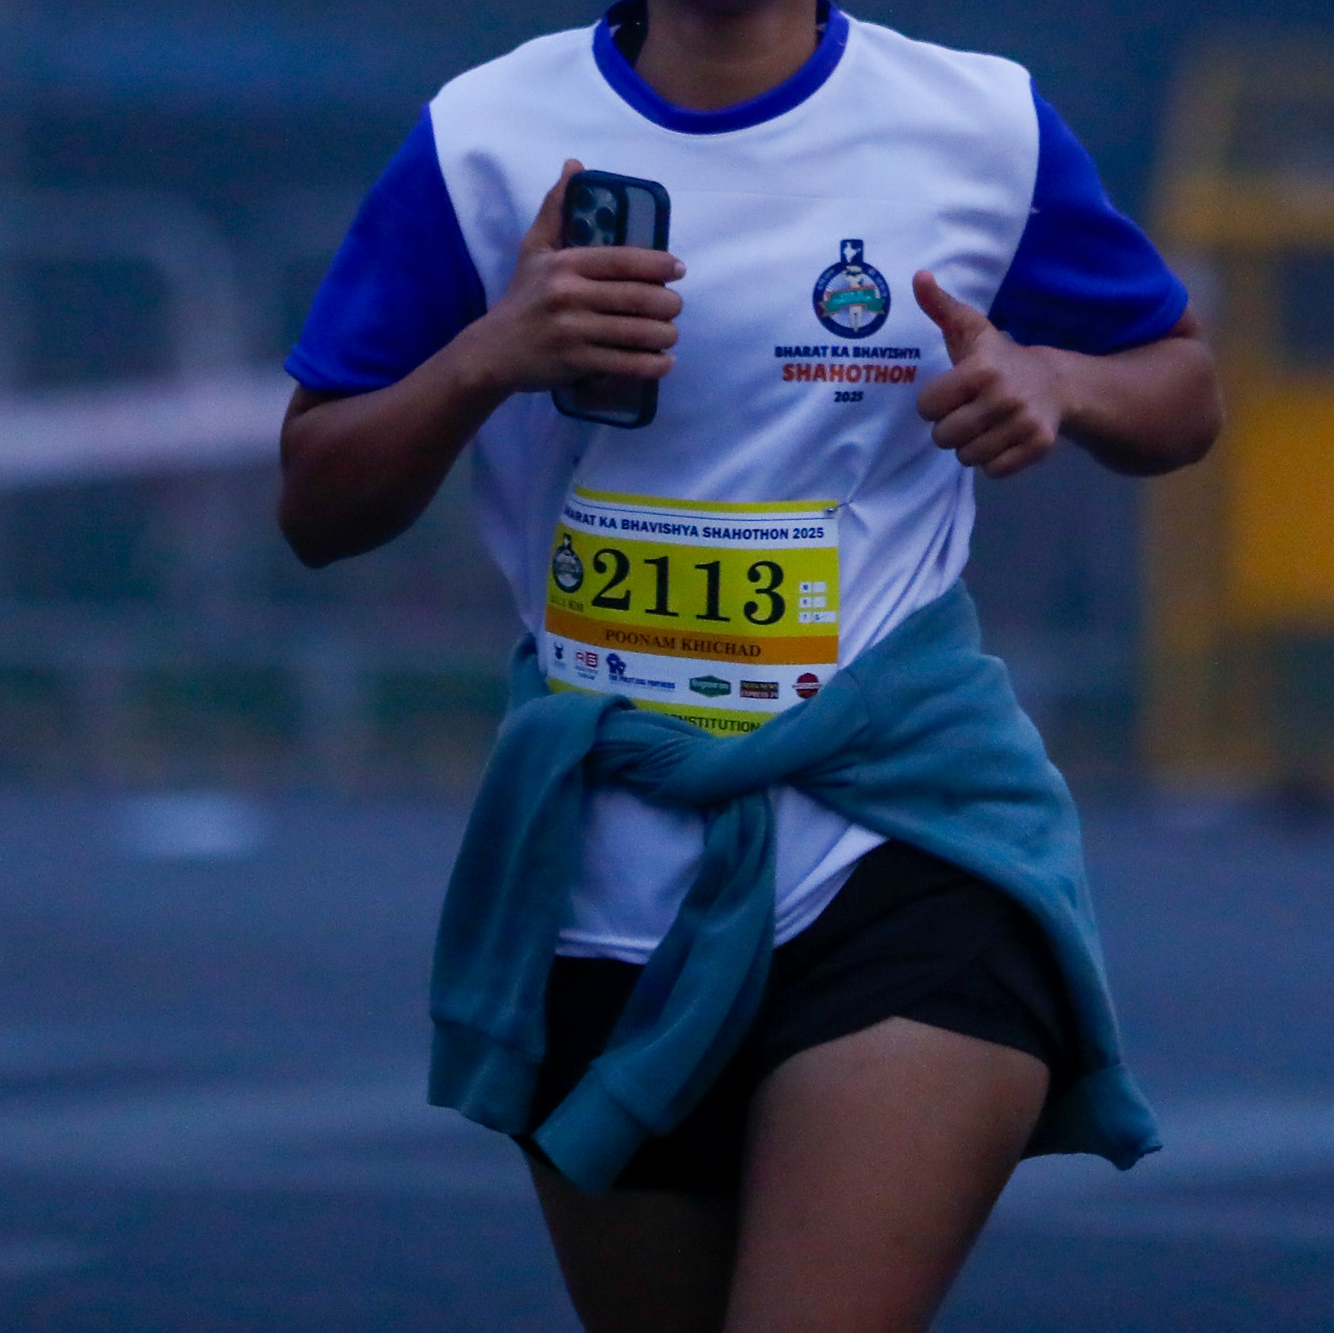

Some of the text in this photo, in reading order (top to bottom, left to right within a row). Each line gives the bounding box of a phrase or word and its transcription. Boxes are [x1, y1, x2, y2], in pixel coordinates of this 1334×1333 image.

[775, 346, 921, 360] BHARAT KA BHAVISHYA
[782, 363, 916, 384] SHAHOTHON
[833, 391, 864, 403] 2025
[599, 516, 617, 529] KA
[621, 519, 699, 537] BHAVISHYA
[703, 527, 788, 540] SHAHOTHON
[793, 527, 825, 539] 2025
[592, 548, 786, 626] 2113
[605, 629, 762, 657] POONAM KHICHAD
